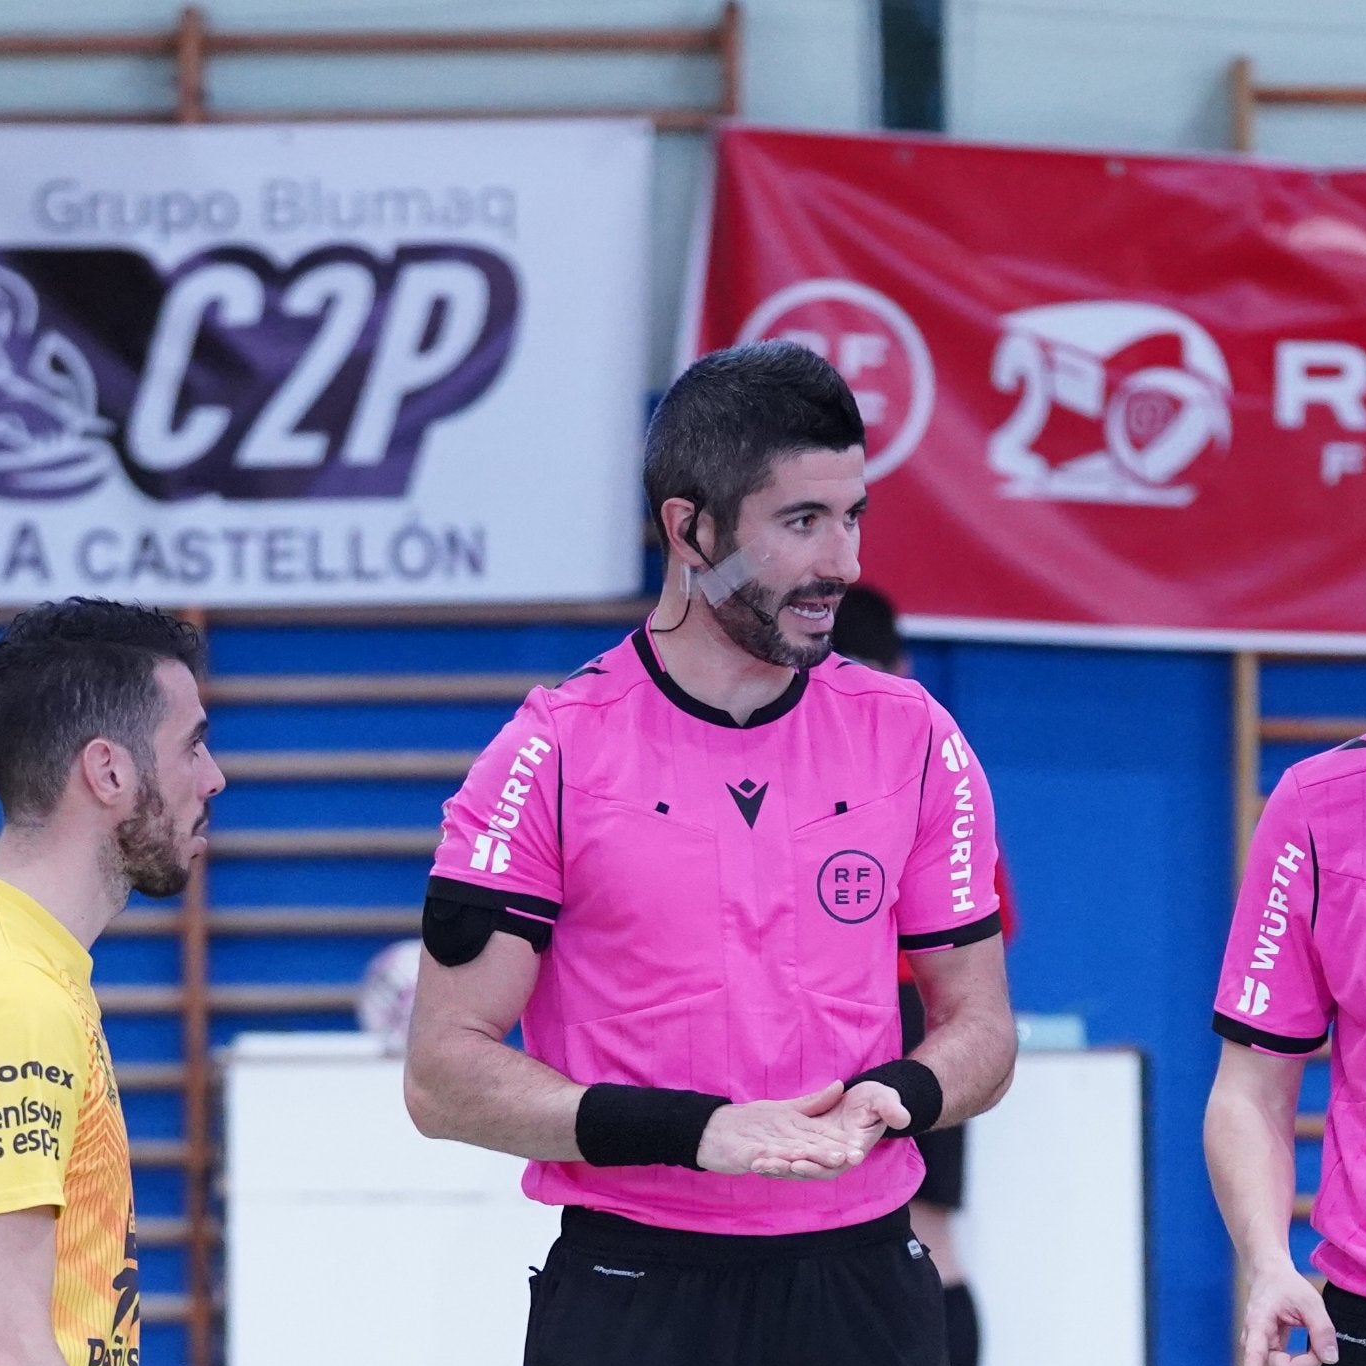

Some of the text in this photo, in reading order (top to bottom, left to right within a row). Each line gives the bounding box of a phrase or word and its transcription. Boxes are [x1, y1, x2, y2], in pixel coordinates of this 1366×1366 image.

[34, 176, 519, 243] Grupo Blumaq
[122, 256, 497, 478] C2P
[75, 511, 488, 586] CASTELLÓN
[488, 736, 552, 843] WÜRTH
[952, 776, 976, 913] WÜRTH
[1250, 842, 1306, 970] WÜRTH
